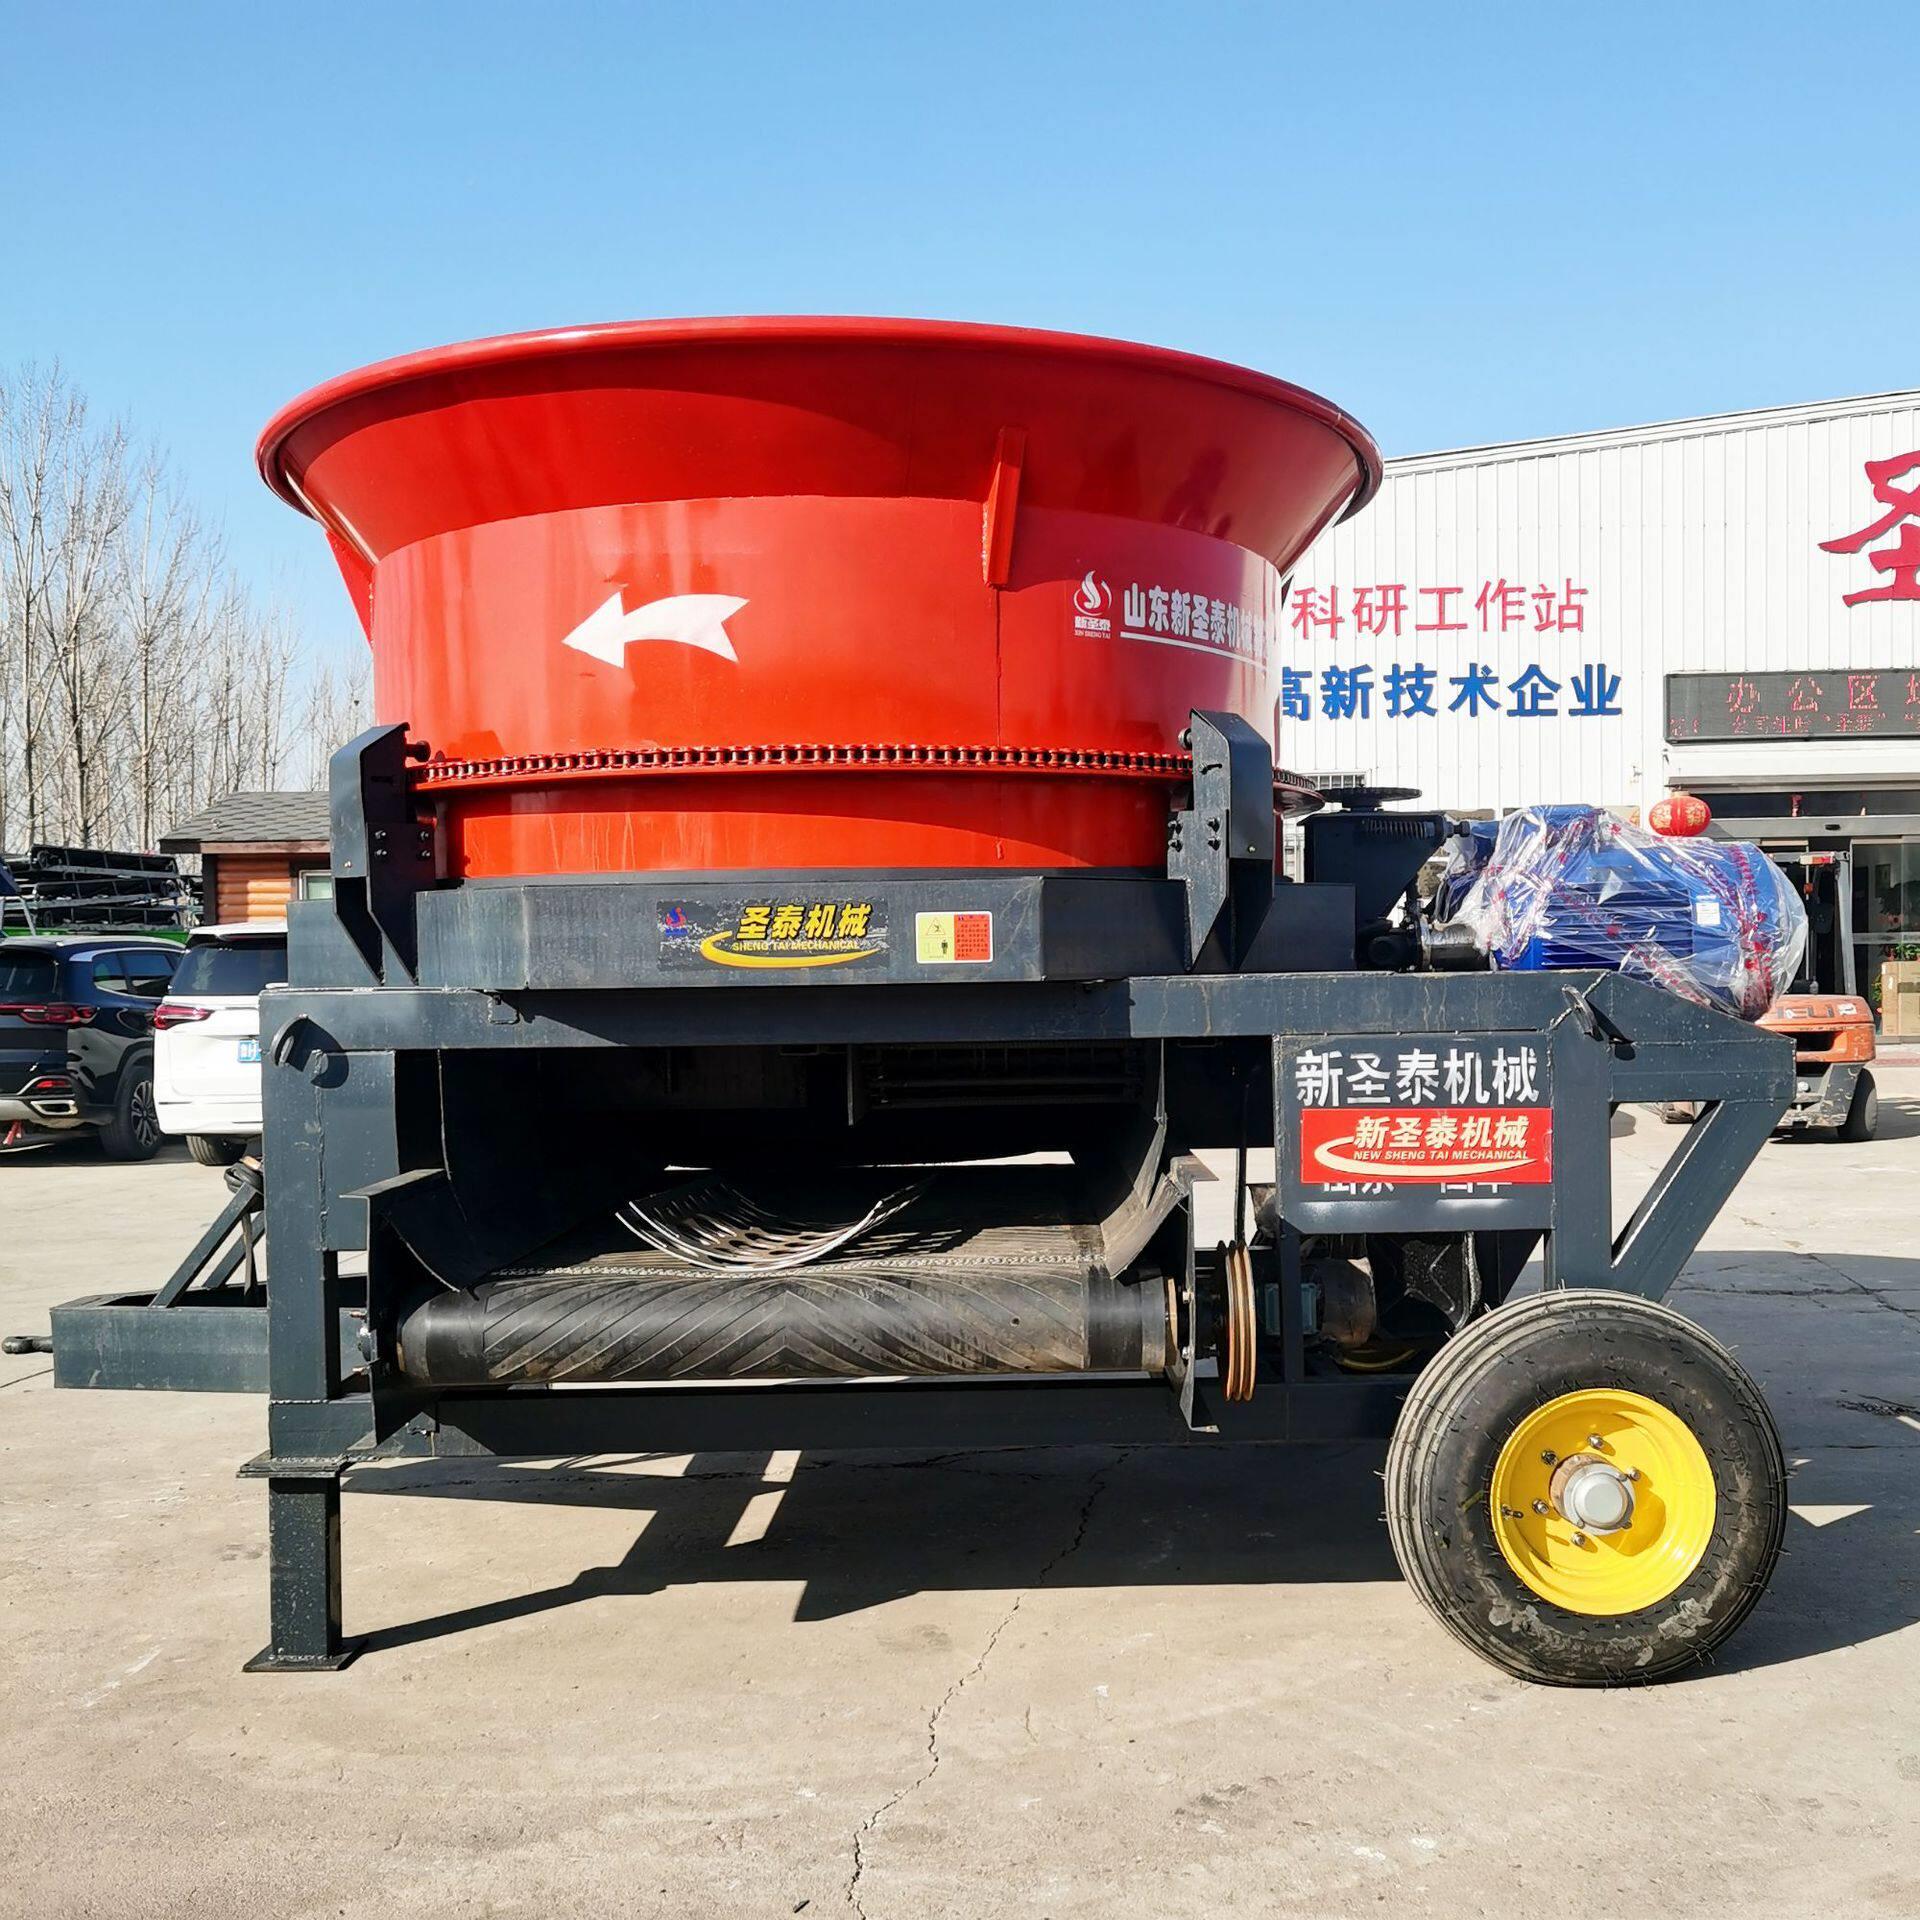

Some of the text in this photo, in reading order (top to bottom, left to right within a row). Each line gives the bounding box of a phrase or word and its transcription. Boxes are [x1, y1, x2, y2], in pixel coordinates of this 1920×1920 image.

[1291, 577, 1589, 640] 科研工作站
[1282, 663, 1623, 721] 高新技术企业
[736, 903, 873, 940] 圣泰机械
[732, 940, 861, 951] SHENG TAI MECHANICAL
[1295, 1046, 1540, 1107] 新圣泰机械
[1353, 1115, 1530, 1149] 新圣泰机械
[1353, 1150, 1529, 1160] NEW SHENG TAI MECHANICAL
